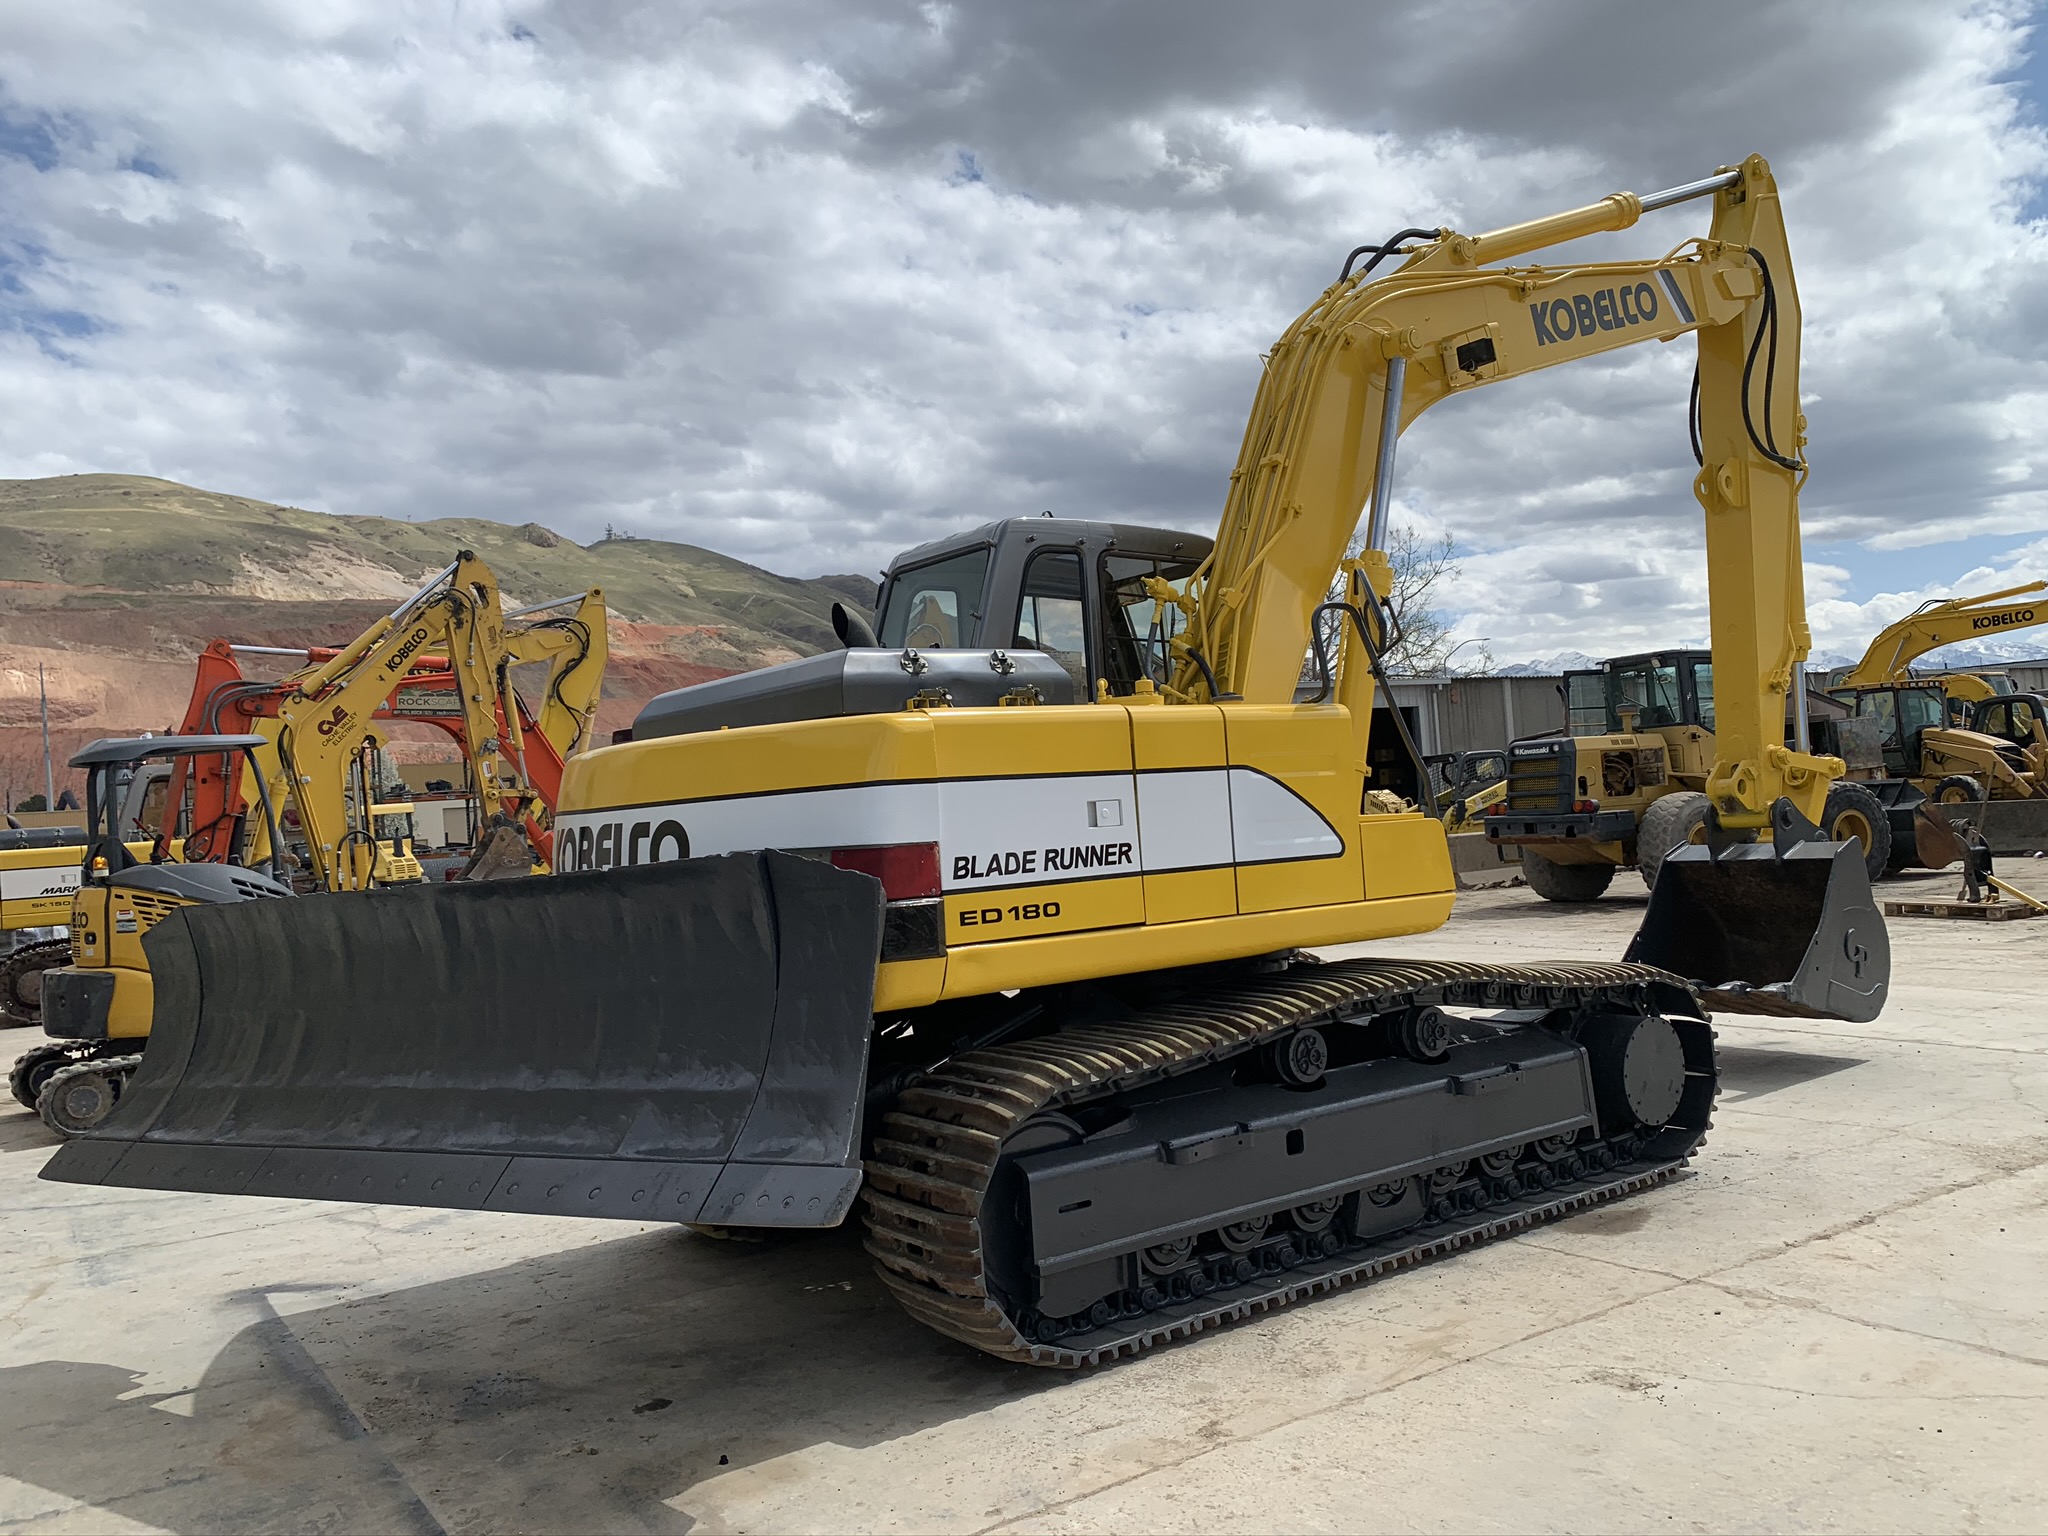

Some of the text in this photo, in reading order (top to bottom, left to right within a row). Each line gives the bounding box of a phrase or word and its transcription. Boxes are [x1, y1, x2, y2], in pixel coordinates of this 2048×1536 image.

[1529, 282, 1658, 347] KOBELCO
[1972, 609, 2034, 630] KOBELCO
[384, 628, 428, 673] KOBELCO
[321, 711, 358, 748] CACHE VALLEY
[332, 721, 358, 747] ELECTRIC
[1519, 746, 1549, 755] Kawasaki
[952, 842, 1133, 880] BLADE RUNNER
[959, 902, 1061, 927] ED 180
